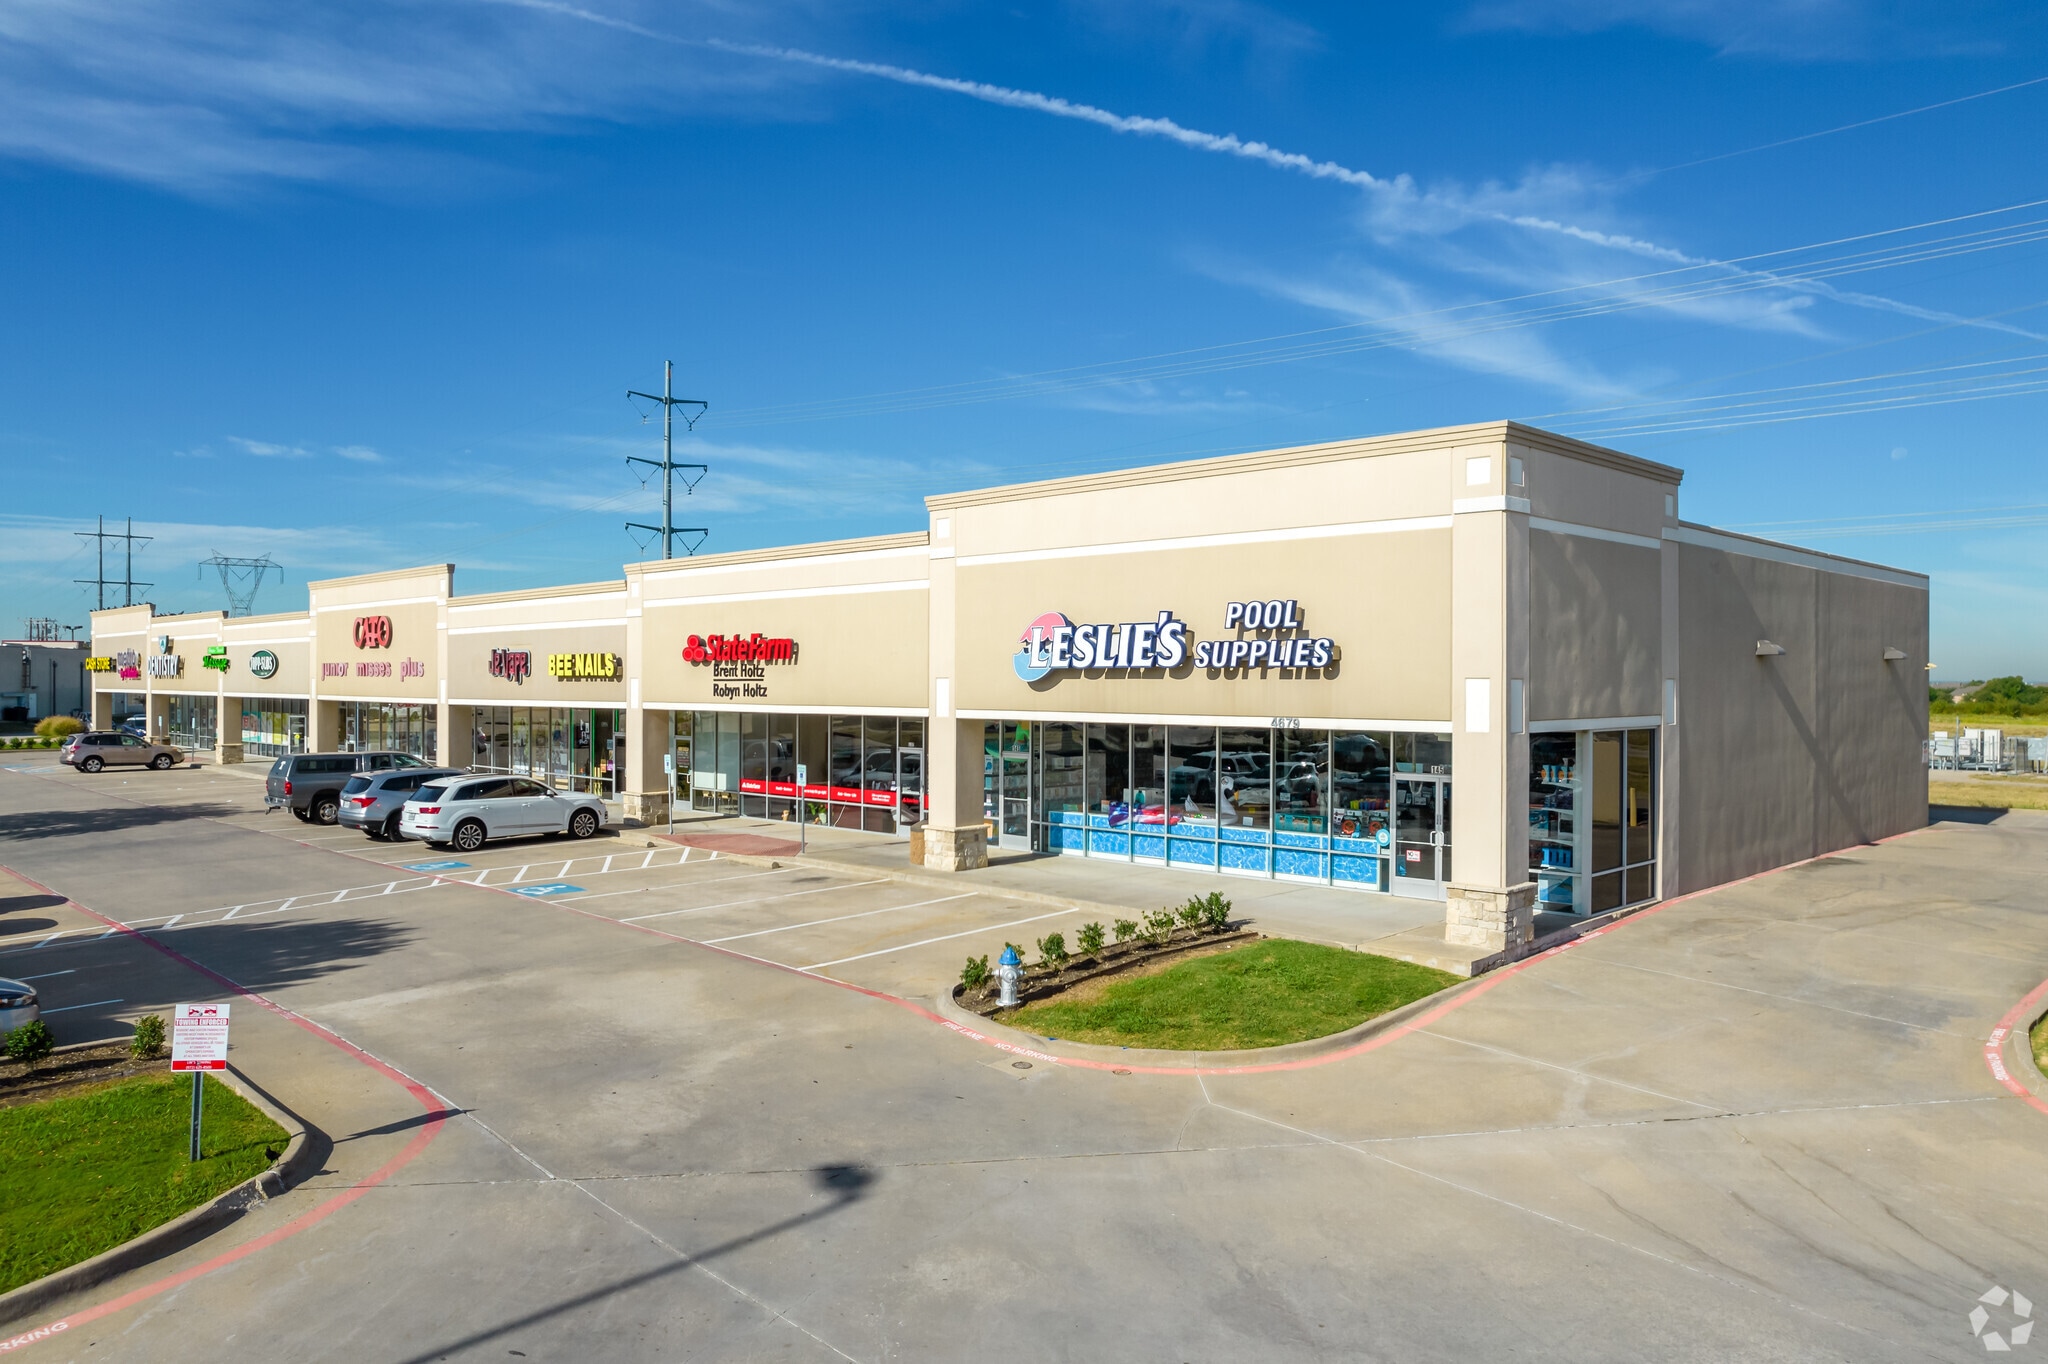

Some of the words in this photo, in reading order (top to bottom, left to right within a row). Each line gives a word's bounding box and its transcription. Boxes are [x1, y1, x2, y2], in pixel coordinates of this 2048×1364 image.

[1225, 600, 1299, 630] POOL
[353, 616, 391, 648] CATO
[1027, 611, 1188, 669] LESLIE'S
[86, 658, 97, 670] CASH
[97, 657, 111, 670] STORE
[148, 655, 179, 676] DENTISTRY
[548, 654, 573, 676] BEE
[575, 652, 615, 677] NAILS
[1194, 638, 1334, 669] SUPPLIES
[321, 662, 349, 681] junior
[356, 661, 392, 677] misses
[400, 657, 424, 682] plus
[713, 664, 738, 677] Brent
[740, 664, 765, 677] Holtz
[713, 684, 740, 700] Robyn
[743, 684, 767, 697] Holtz
[1271, 717, 1300, 729] 4679
[176, 1018, 198, 1026] TOWING
[200, 1018, 228, 1026] ENFORCED
[941, 1021, 962, 1031] FIRE
[959, 1027, 985, 1040] LANE
[994, 1042, 1011, 1051] NO
[1011, 1047, 1059, 1062] PARKING
[0, 1322, 69, 1353] RKING
